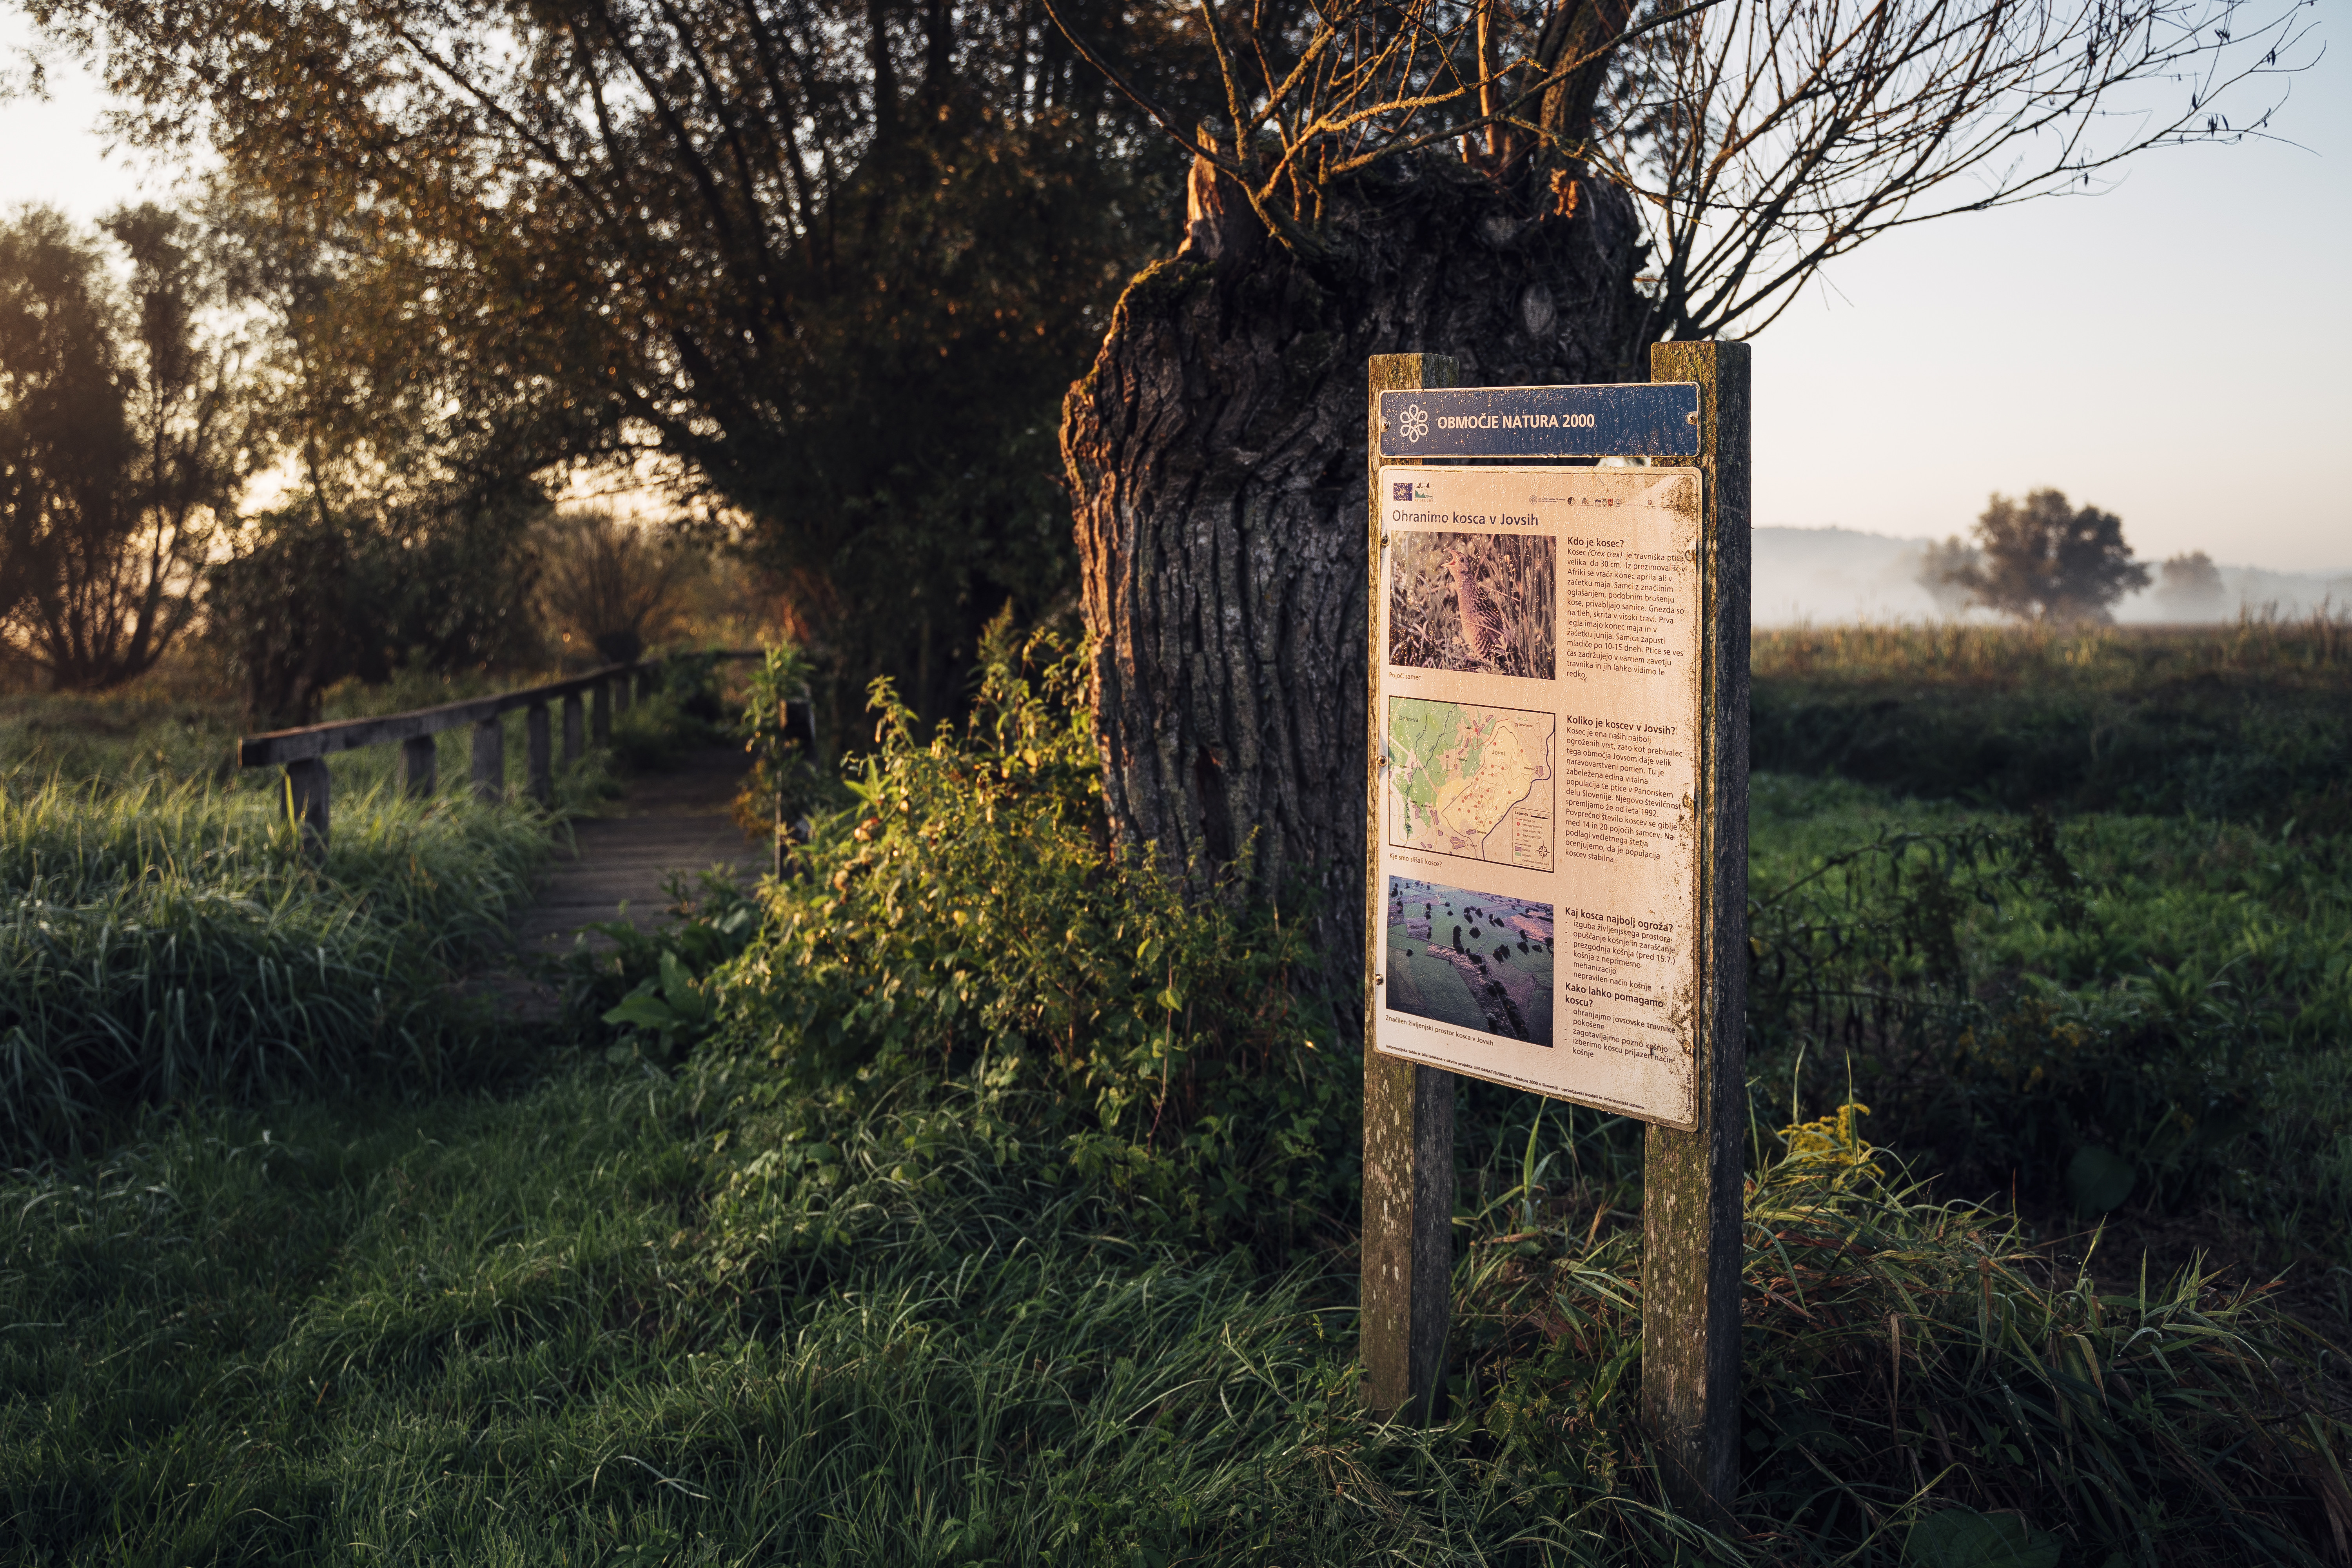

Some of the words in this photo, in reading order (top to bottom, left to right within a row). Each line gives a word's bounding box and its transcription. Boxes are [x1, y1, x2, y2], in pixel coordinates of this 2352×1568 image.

[1437, 412, 1498, 429] OBMOČJE
[1503, 415, 1558, 428] NATURA
[1563, 414, 1595, 427] 2000
[1392, 508, 1448, 523] Ohranimo
[1453, 510, 1485, 524] kosca
[1490, 515, 1496, 524] v
[1500, 512, 1539, 526] Jovsih
[1567, 536, 1584, 546] Kdo
[1586, 537, 1593, 548] je
[1596, 537, 1624, 548] kosec?
[1588, 549, 1605, 557] (Crex
[1606, 551, 1622, 559] crex)
[1626, 551, 1632, 560] je
[1567, 579, 1592, 587] začetku
[1567, 589, 1606, 599] oglašanjem,
[1608, 592, 1642, 601] podobnim
[1644, 594, 1674, 604] brušenju
[1567, 599, 1583, 608] kose,
[1585, 601, 1620, 611] privabljajo
[1648, 605, 1675, 613] Gnezda
[1577, 610, 1591, 619] tleh,
[1567, 619, 1584, 628] legla
[1584, 620, 1603, 630] imajo
[1626, 624, 1642, 633] maja
[1594, 631, 1613, 641] junija.
[1567, 640, 1592, 648] mladiče
[1605, 643, 1622, 651] 10-15
[1624, 644, 1643, 653] dneh.
[1578, 651, 1612, 661] zadržujejo
[1566, 661, 1593, 669] travnika
[1613, 664, 1632, 672] lahko
[1633, 666, 1657, 675] vidimo
[1567, 715, 1593, 726] Koliko
[1595, 718, 1603, 729] je
[1605, 719, 1633, 730] koscev
[1644, 723, 1675, 735] Jovsih?
[1567, 727, 1585, 735] Kosec
[1587, 729, 1593, 737] je
[1608, 732, 1627, 740] naših
[1566, 738, 1600, 747] ogroženih
[1634, 744, 1645, 753] kot
[1647, 748, 1682, 757] prebivalec
[1566, 748, 1581, 757] tega
[1583, 750, 1611, 760] območja
[1613, 753, 1637, 762] Jovsom
[1566, 759, 1618, 770] naravovarstveni
[1620, 766, 1645, 774] pomen.
[1658, 769, 1664, 777] je
[1566, 769, 1603, 779] zabeležena
[1605, 773, 1623, 781] edina
[1625, 775, 1648, 784] vitalna
[1566, 788, 1580, 796] delu
[1582, 790, 1613, 802] Slovenije.
[1615, 795, 1643, 804] Njegovo
[1645, 798, 1681, 809] številčnost
[1566, 800, 1604, 809] spremljamo
[1642, 808, 1659, 817] 1992.
[1566, 808, 1600, 819] Povprečno
[1601, 813, 1623, 822] število
[1625, 816, 1647, 826] koscev
[1566, 829, 1590, 840] podlagi
[1592, 833, 1628, 845] večletnega
[1609, 826, 1634, 835] pojočih
[1565, 840, 1604, 852] ocenjujemo,
[1607, 844, 1615, 853] da
[1617, 846, 1623, 855] je
[1625, 849, 1660, 860] populacija
[1565, 849, 1586, 858] koscev
[1588, 853, 1616, 863] stabilna.
[1425, 858, 1442, 867] kosce?
[1565, 907, 1578, 919] Kaj
[1581, 909, 1603, 921] kosca
[1606, 915, 1635, 928] najbolj
[1637, 920, 1673, 932] ogroža?
[1573, 920, 1595, 930] izguba
[1597, 923, 1639, 938] življenjskega
[1573, 932, 1606, 943] opuščanje
[1608, 936, 1629, 947] košnje
[1573, 942, 1610, 954] prezgodnja
[1636, 950, 1654, 960] (pred
[1573, 951, 1594, 962] košnja
[1573, 962, 1617, 975] mehanizacijo
[1573, 973, 1608, 983] nepravilen
[1610, 978, 1628, 987] način
[1630, 980, 1651, 992] košnje
[1565, 982, 1586, 994] Kako
[1588, 986, 1612, 998] lahko
[1614, 993, 1663, 1007] pomagamo
[1565, 995, 1593, 1007] koscu?
[1573, 1009, 1611, 1021] ohranjajmo
[1613, 1015, 1644, 1027] jovsovske
[1647, 1022, 1675, 1033] travnike
[1573, 1019, 1605, 1029] pokošene
[1386, 1015, 1407, 1025] Značilen
[1408, 1020, 1433, 1032] življenjski
[1435, 1028, 1454, 1036] prostor
[1455, 1031, 1471, 1040] kosca
[1477, 1037, 1494, 1046] Jovsih
[1573, 1029, 1619, 1043] zagotavljajmo
[1621, 1039, 1643, 1047] pozno
[1572, 1047, 1594, 1058] košnje
[1573, 1037, 1602, 1049] izberimo
[1603, 1043, 1622, 1053] koscu
